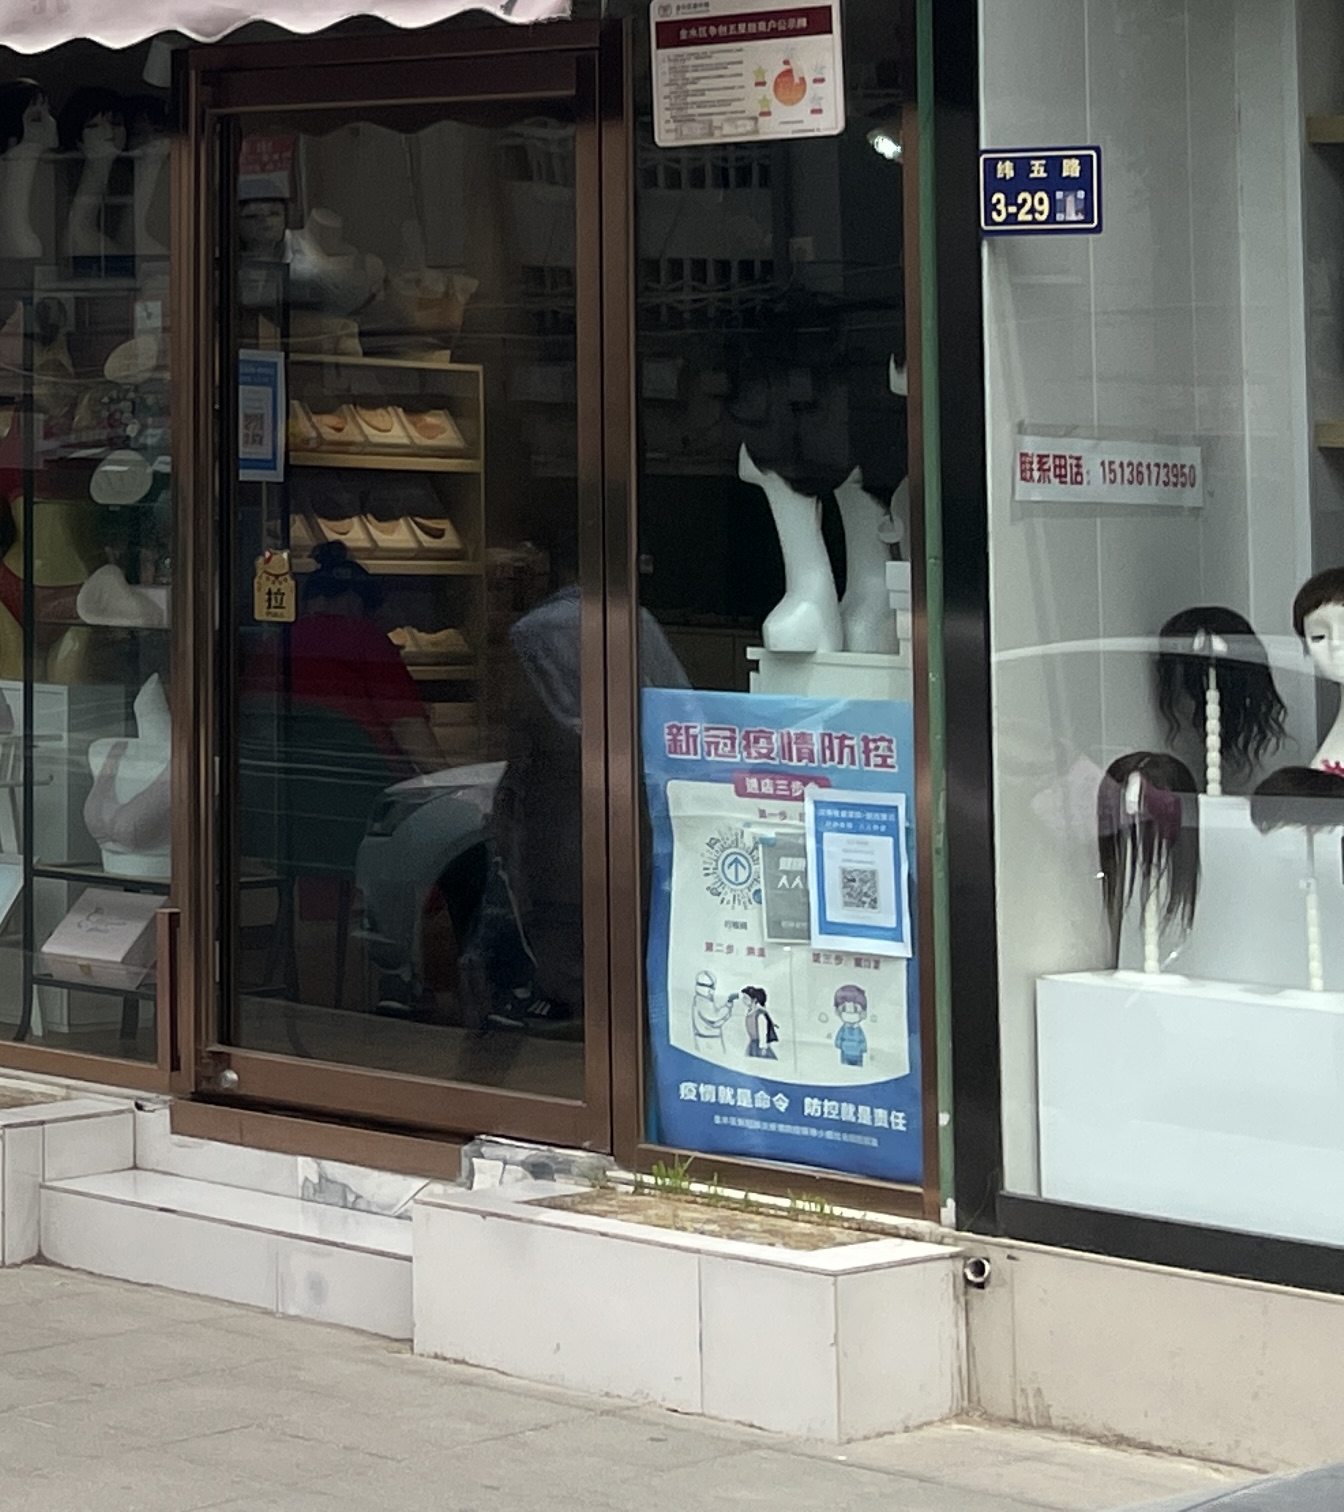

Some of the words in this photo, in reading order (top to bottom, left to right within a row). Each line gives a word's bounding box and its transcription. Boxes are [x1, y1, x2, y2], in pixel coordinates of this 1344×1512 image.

[995, 158, 1082, 181] 纬五路
[991, 191, 1050, 223] 3-29
[1100, 459, 1196, 488] 15136173950
[264, 586, 287, 610] 拉
[664, 722, 898, 772] 新冠疫情防控
[678, 1081, 790, 1113] 疫情就是命令
[803, 1096, 908, 1132] 防控就是责任
